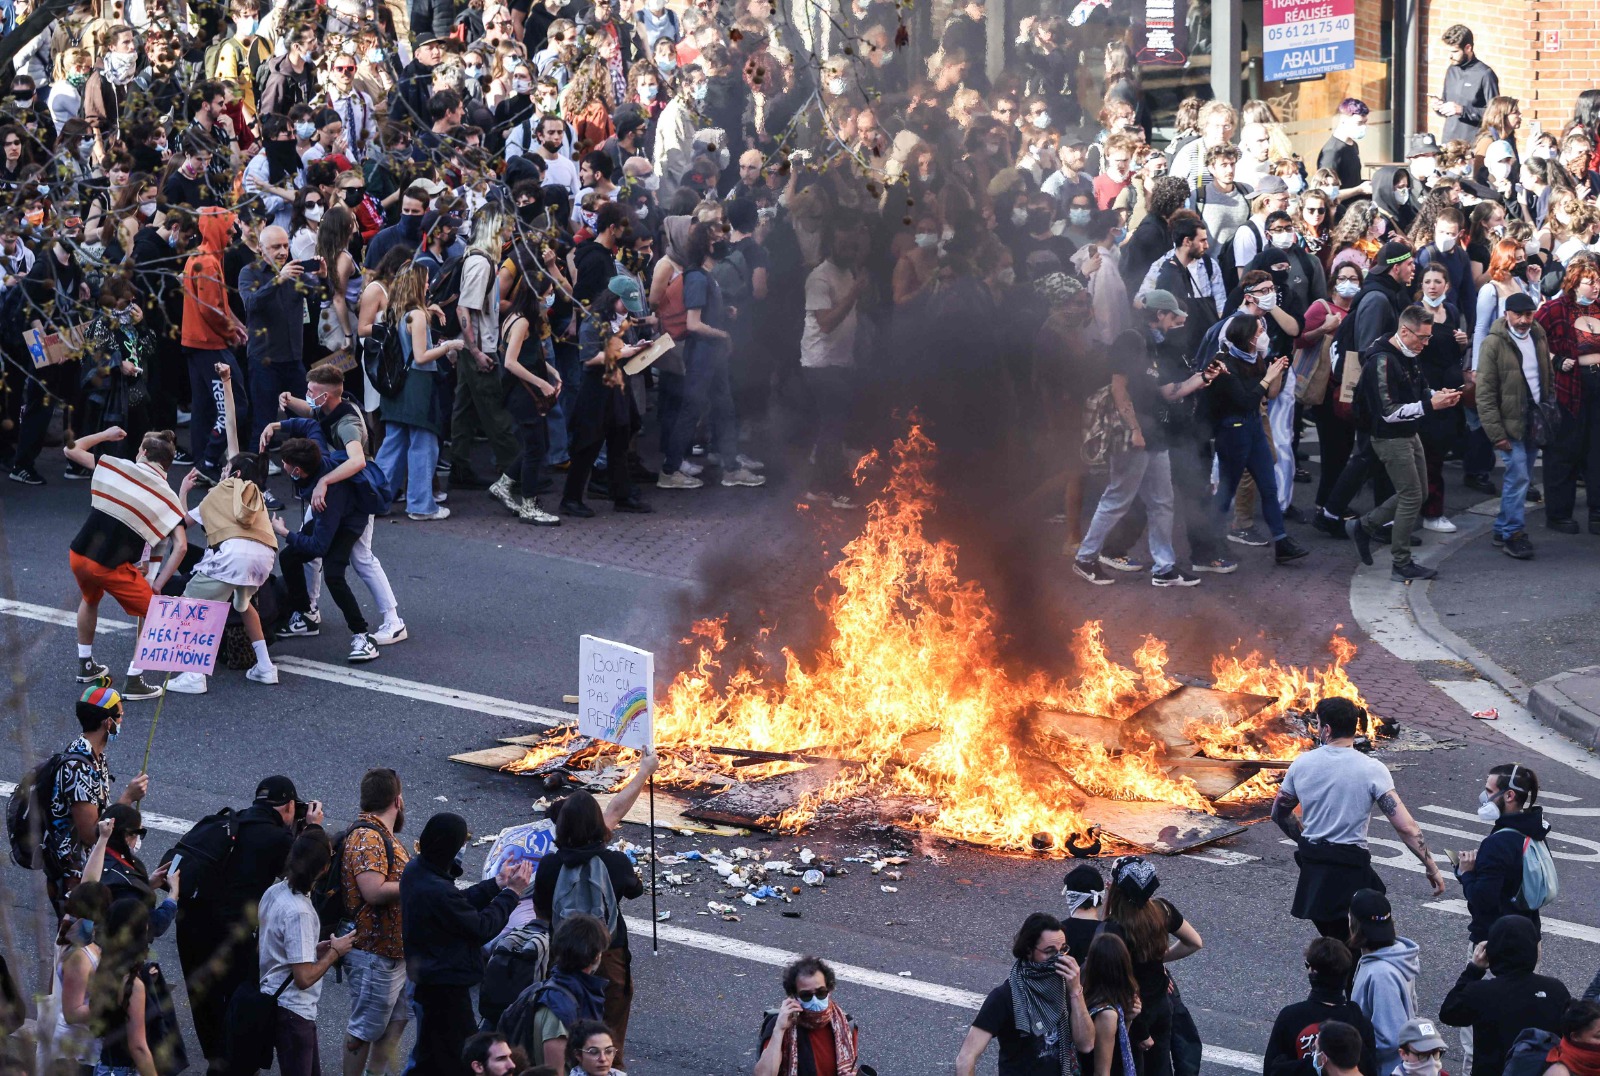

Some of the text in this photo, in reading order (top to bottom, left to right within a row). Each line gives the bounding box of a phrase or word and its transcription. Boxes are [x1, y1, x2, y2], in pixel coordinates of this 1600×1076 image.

[1285, 4, 1333, 22] RÉALISÉE
[1268, 18, 1350, 41] 05 61 21 75 40
[1281, 46, 1339, 70] ABAULT
[159, 601, 209, 620] TAXE
[593, 653, 637, 675] BOUFFE
[587, 674, 605, 685] MON
[587, 688, 609, 703] PAS
